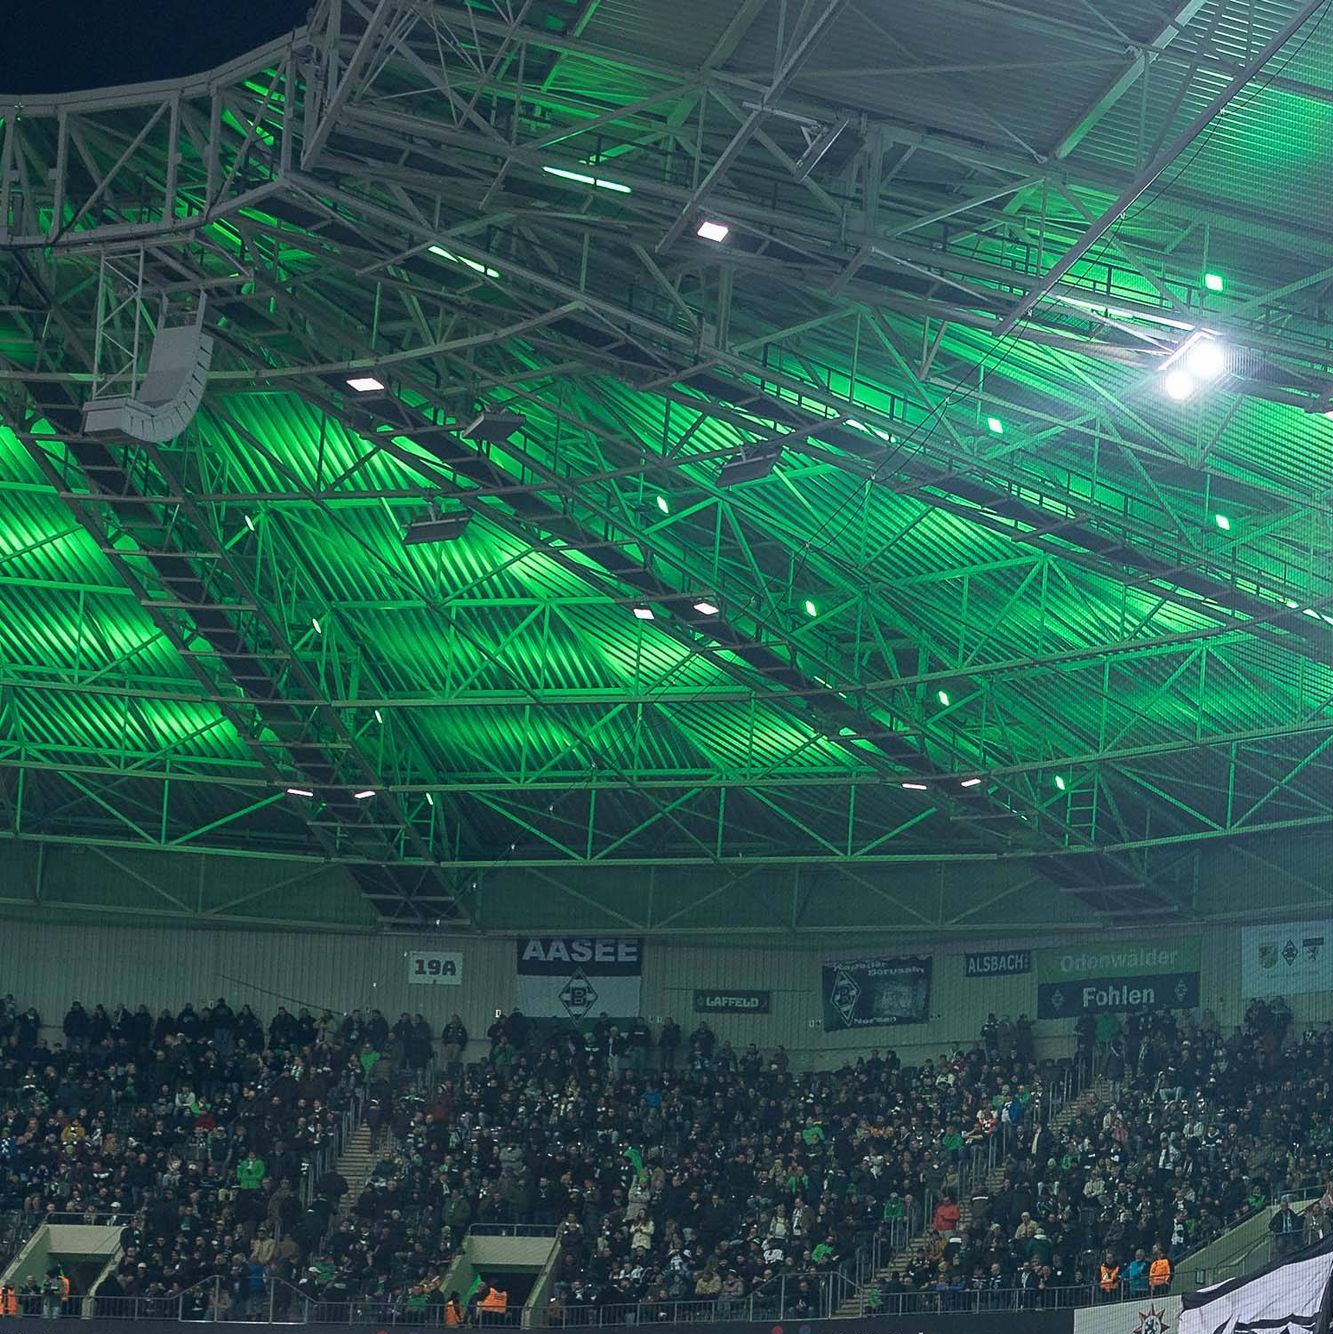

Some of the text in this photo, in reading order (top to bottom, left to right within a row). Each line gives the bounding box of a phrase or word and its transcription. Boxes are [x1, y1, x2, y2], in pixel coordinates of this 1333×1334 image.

[521, 937, 639, 962] AASEE
[1060, 948, 1178, 972] Odenwälder
[414, 959, 457, 977] 19A
[705, 996, 760, 1008] LAFFELD
[1082, 985, 1155, 1009] Fohlen
